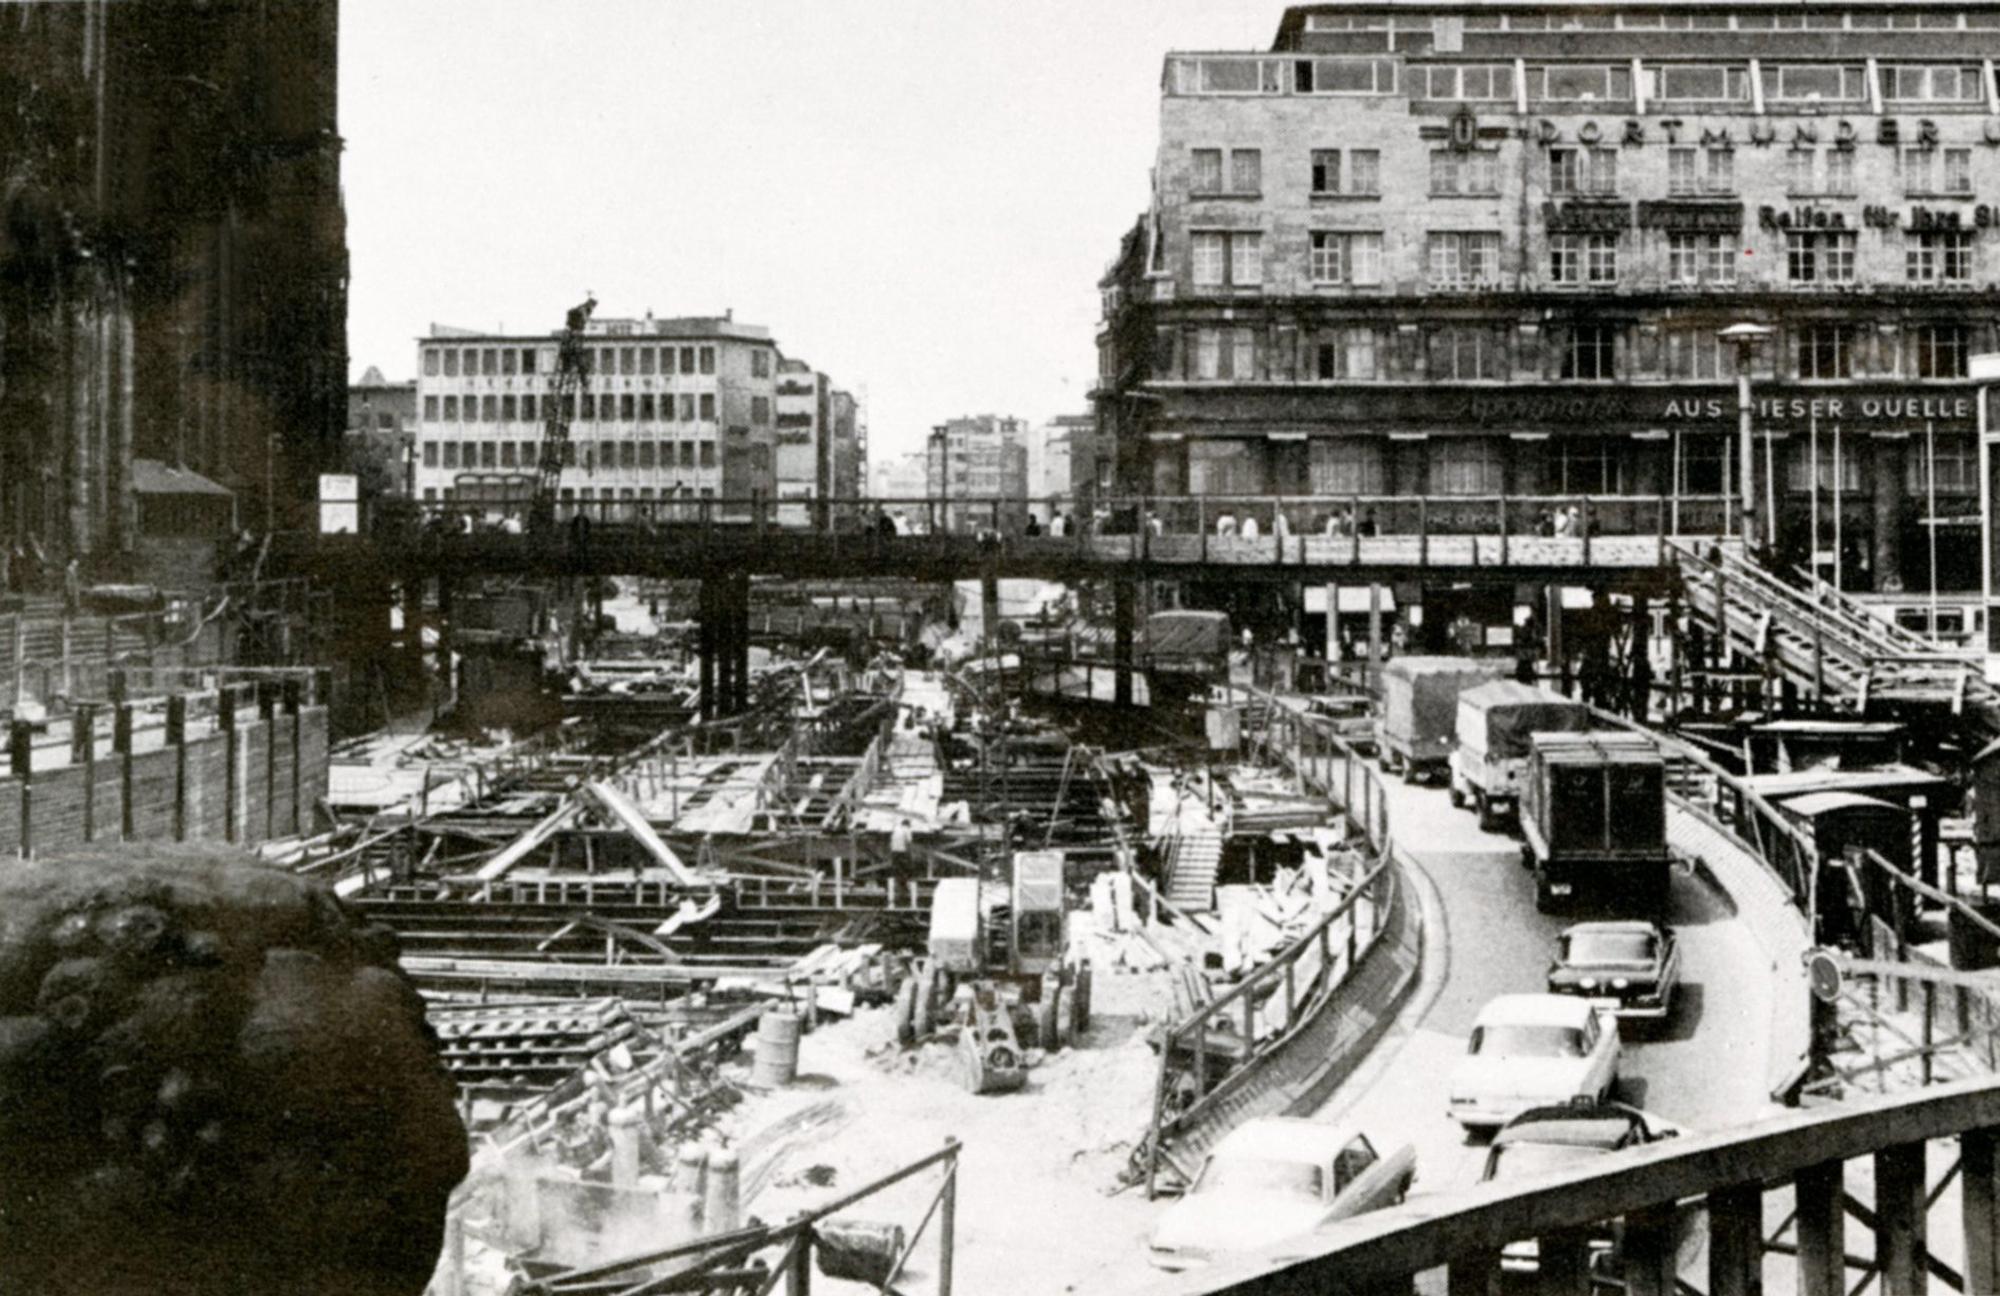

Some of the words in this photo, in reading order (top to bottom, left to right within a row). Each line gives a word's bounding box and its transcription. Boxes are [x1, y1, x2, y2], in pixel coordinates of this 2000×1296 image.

[1538, 117, 1940, 150] DORTMUNDER
[1664, 399, 1723, 418] AUS
[1750, 399, 1844, 418] IESER
[1861, 398, 1969, 418] QUELLE
